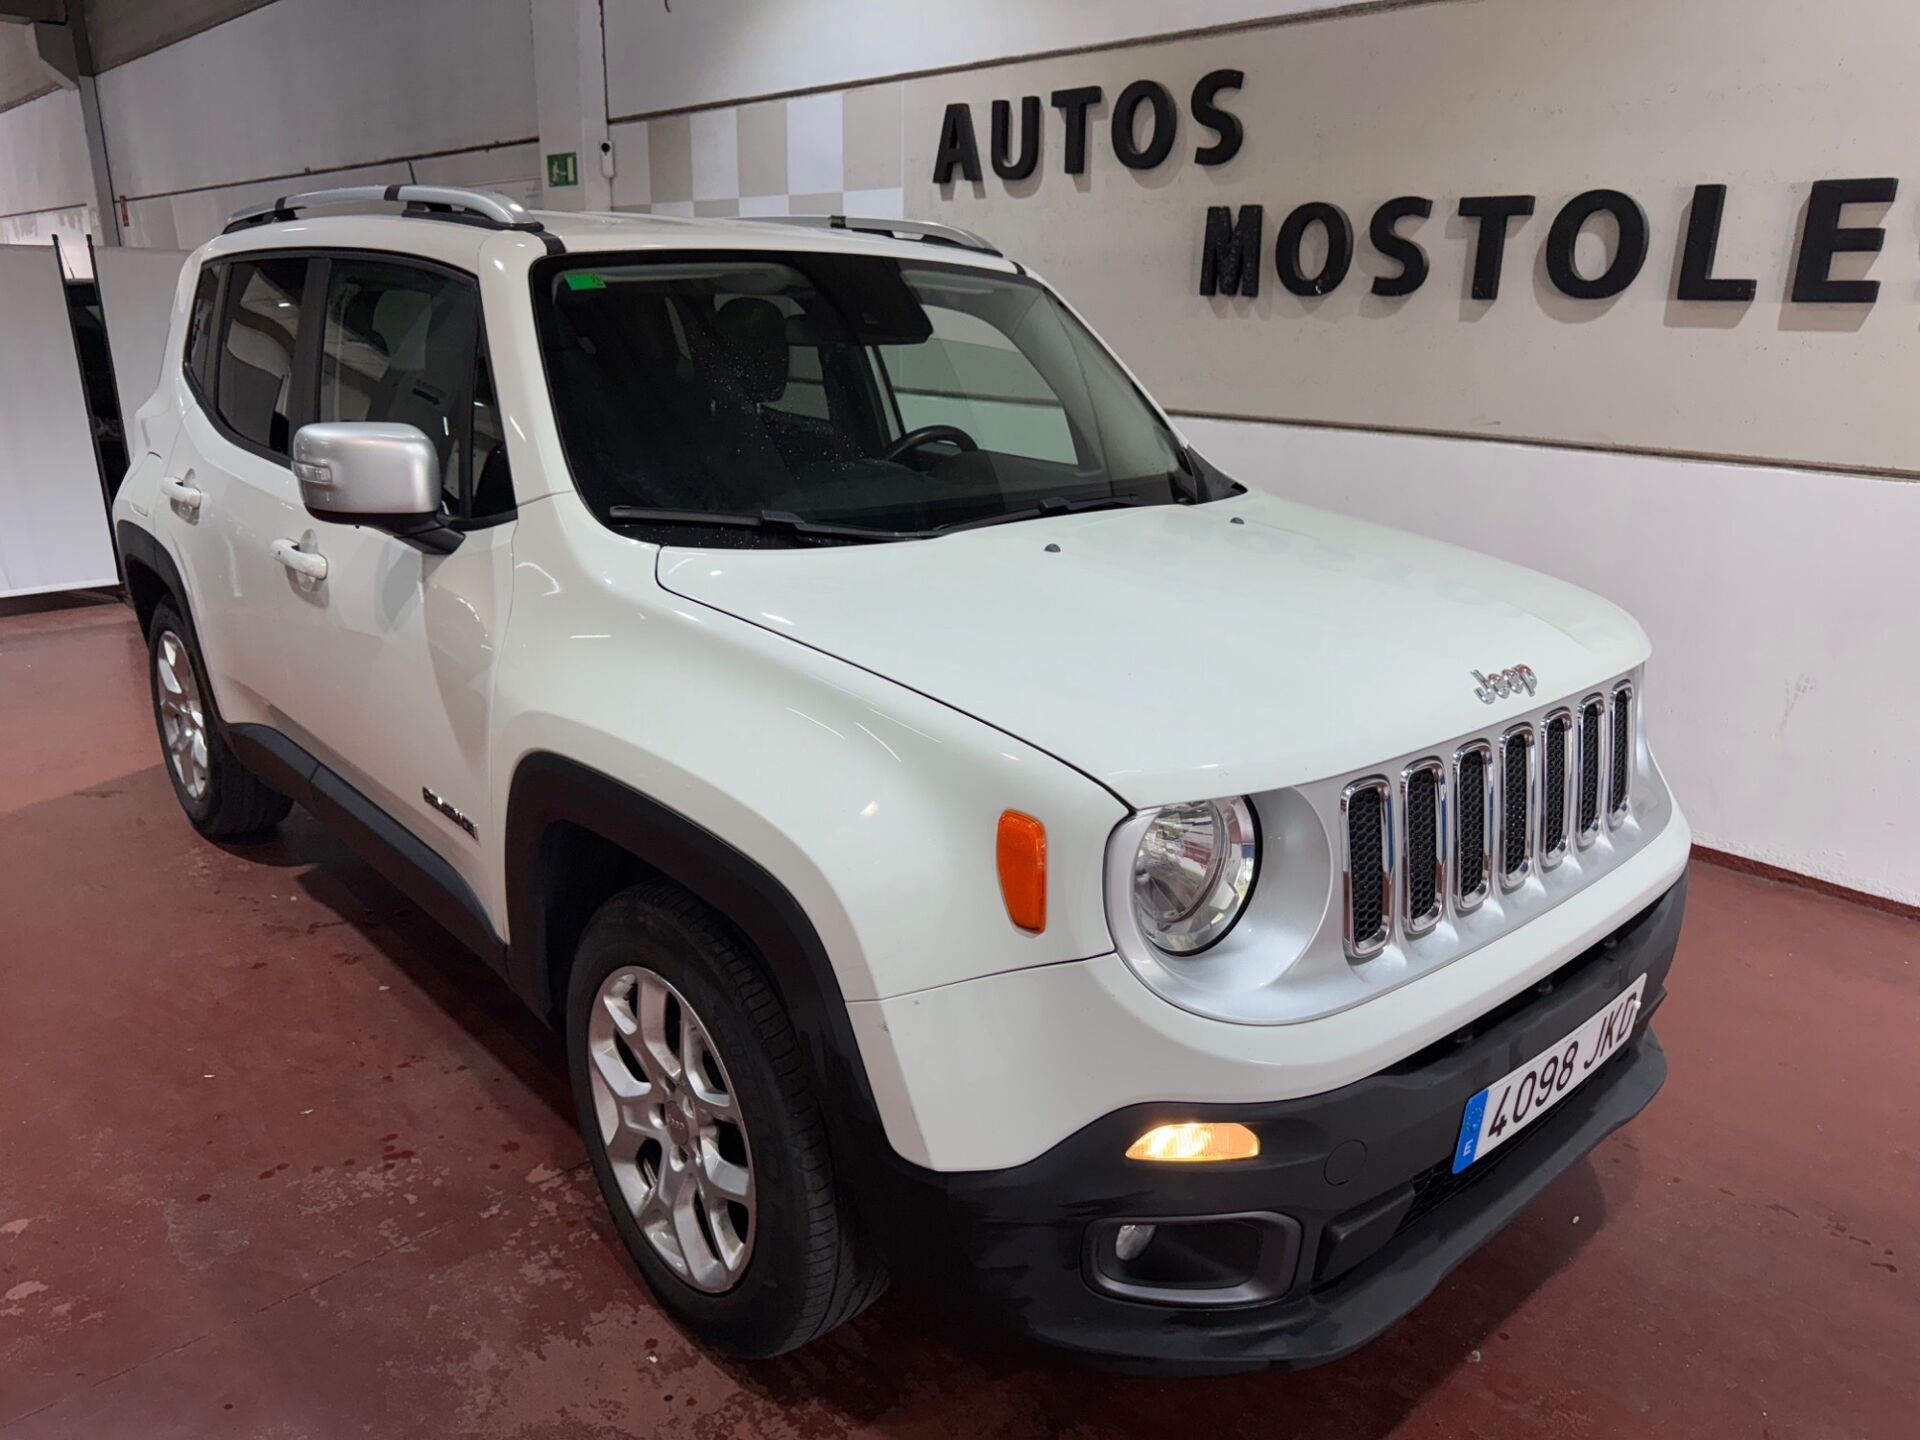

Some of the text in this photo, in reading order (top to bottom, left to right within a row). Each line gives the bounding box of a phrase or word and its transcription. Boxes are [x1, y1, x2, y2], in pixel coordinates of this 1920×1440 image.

[933, 69, 1245, 183] AUTOS
[1199, 177, 1920, 303] MOSTOLE
[1470, 663, 1537, 704] Jeep
[1488, 991, 1637, 1138] 4098 JKD
